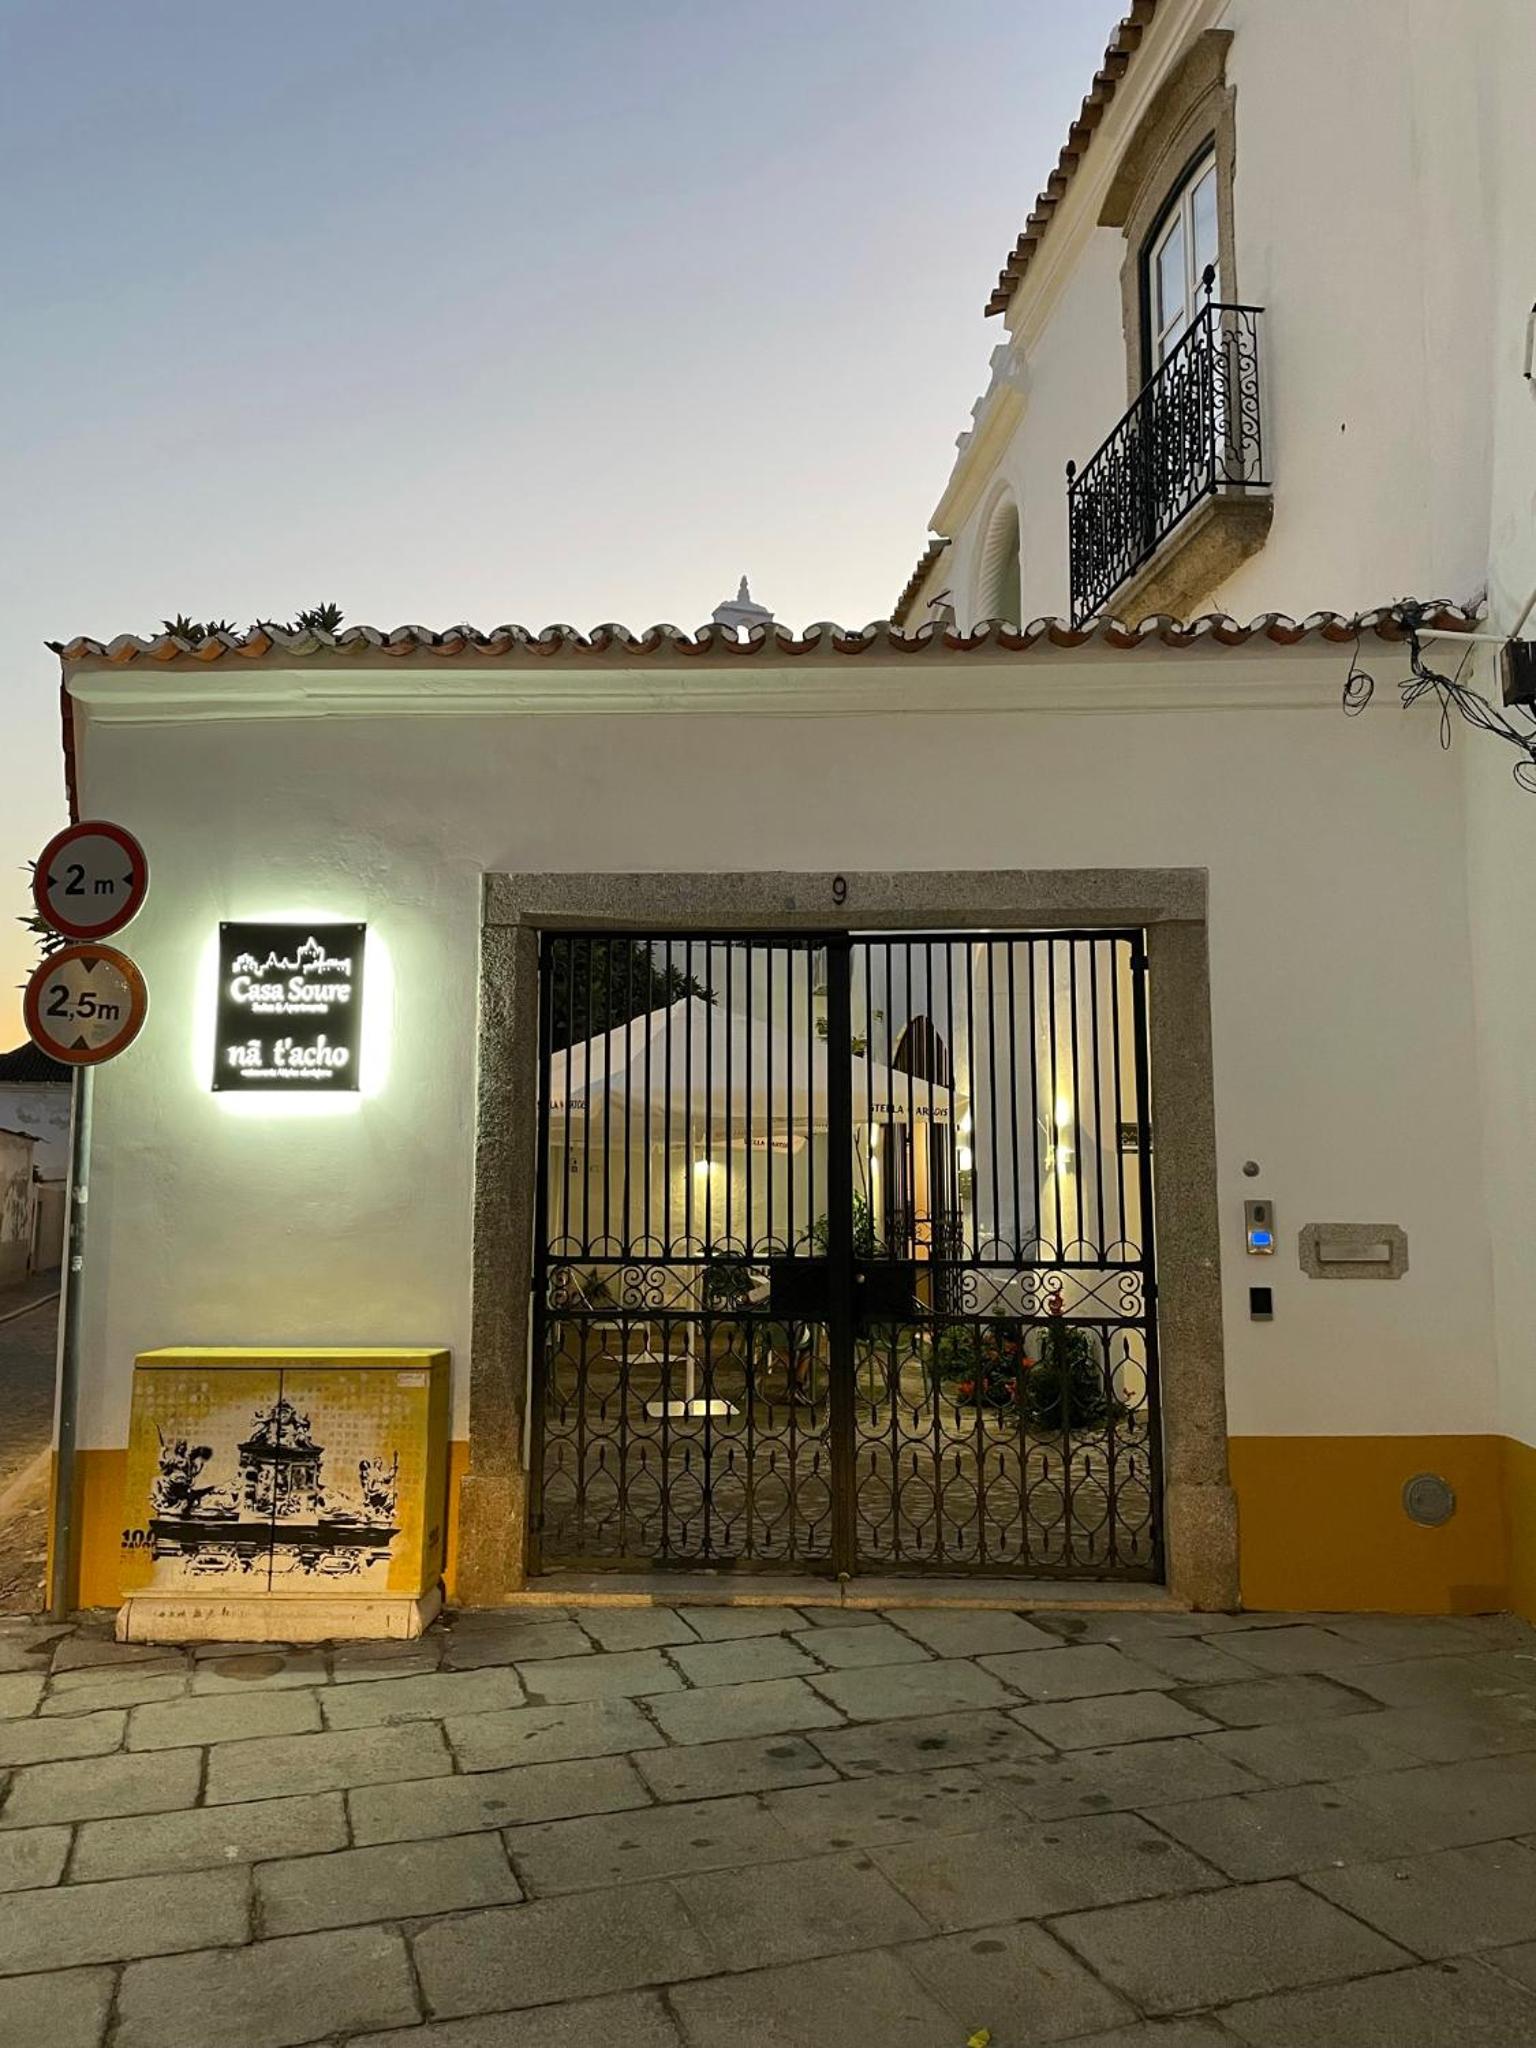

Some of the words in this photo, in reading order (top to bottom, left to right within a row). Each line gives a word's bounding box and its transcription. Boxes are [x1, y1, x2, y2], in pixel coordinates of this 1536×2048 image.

[64, 864, 85, 895] 2
[94, 879, 114, 895] m
[832, 876, 847, 905] 9
[230, 976, 285, 1003] Casa
[287, 976, 352, 1003] Soure
[273, 1034, 350, 1067] t'acho
[869, 1103, 904, 1114] STELA
[915, 1106, 948, 1117] AROIS
